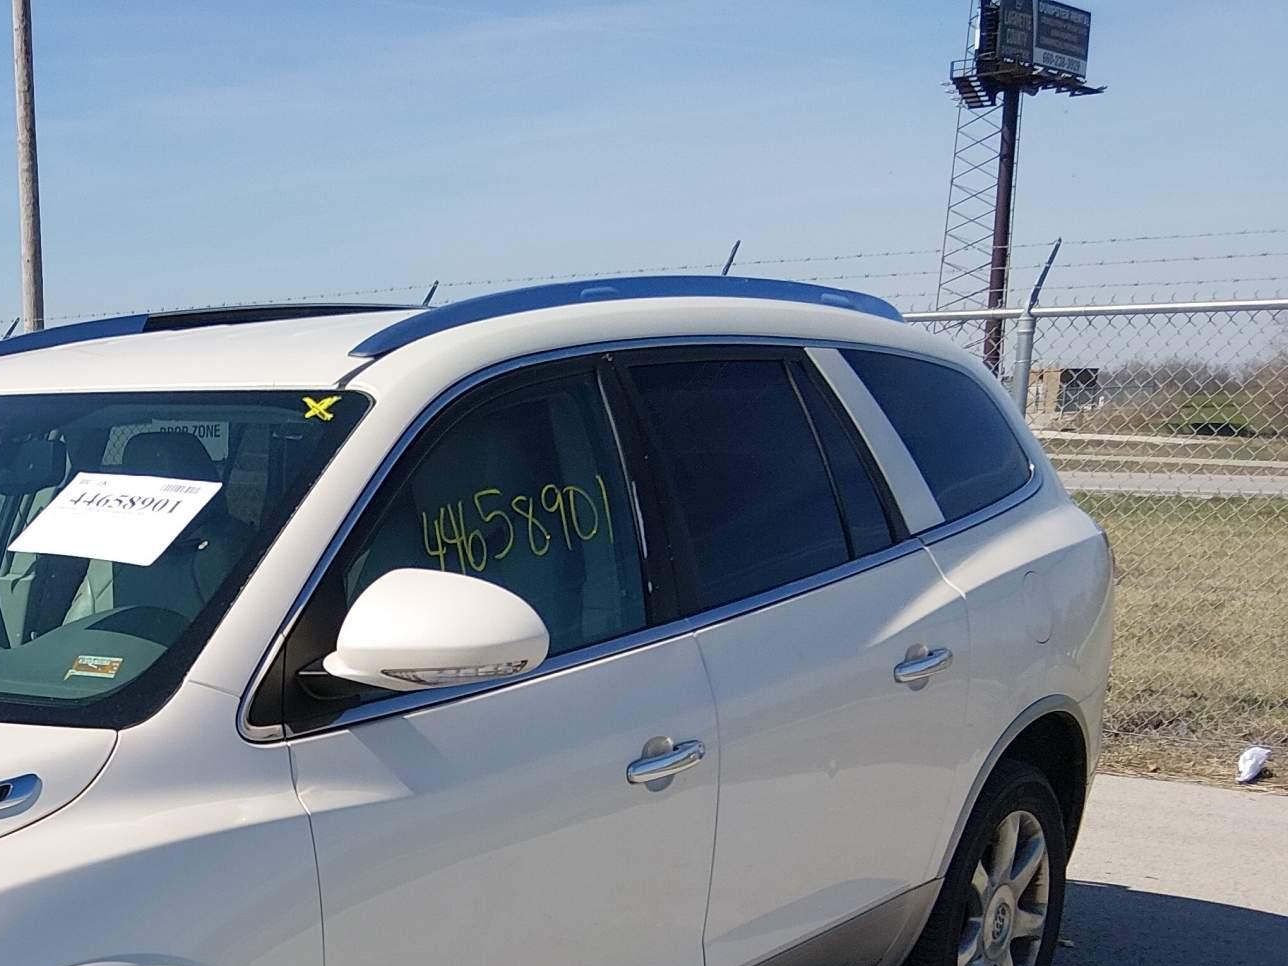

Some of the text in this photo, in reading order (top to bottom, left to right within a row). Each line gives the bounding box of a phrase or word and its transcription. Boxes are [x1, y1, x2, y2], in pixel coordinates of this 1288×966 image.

[193, 423, 221, 438] ZONE
[69, 491, 183, 514] 44658901
[423, 474, 614, 575] 44658901
